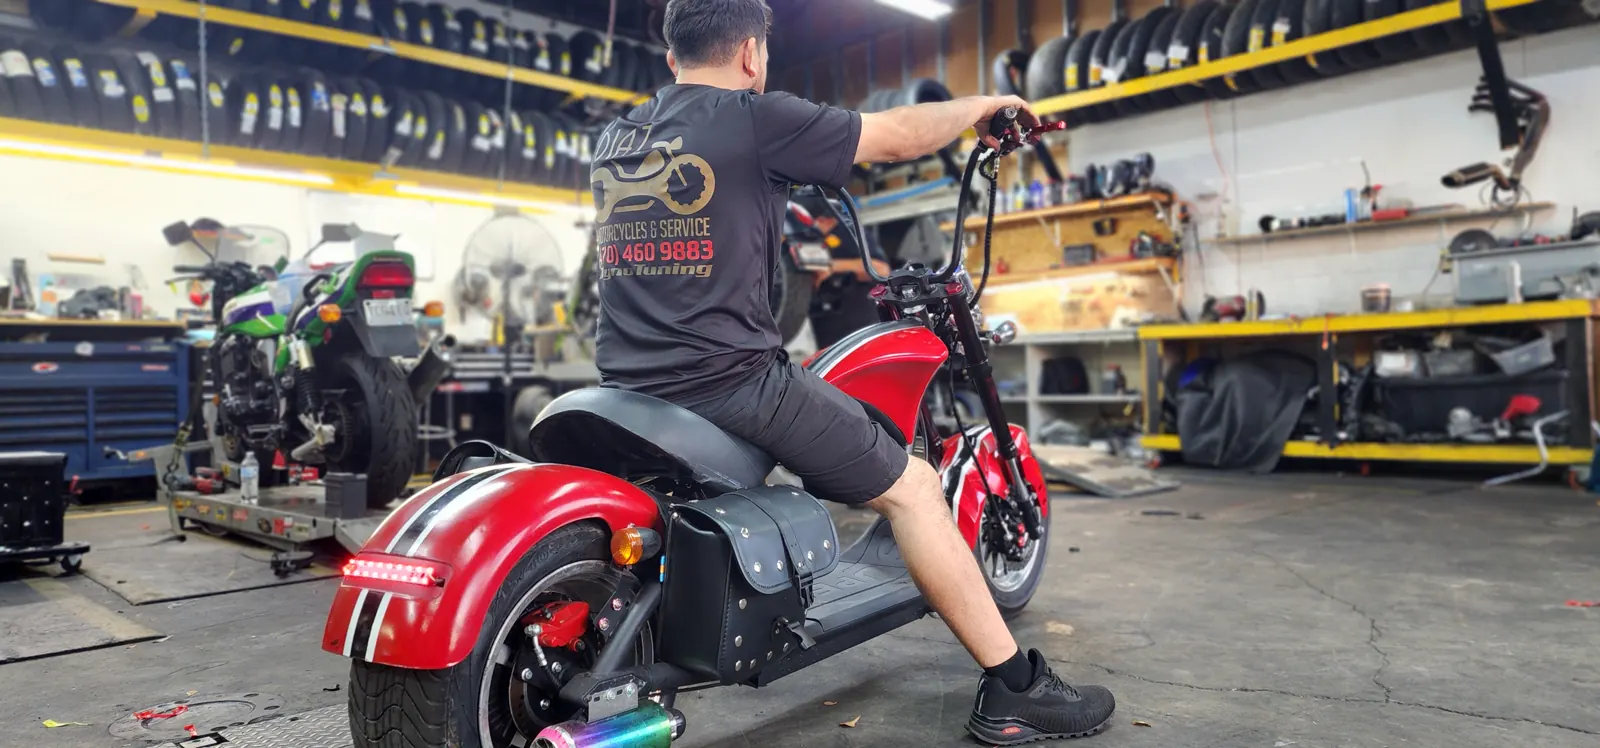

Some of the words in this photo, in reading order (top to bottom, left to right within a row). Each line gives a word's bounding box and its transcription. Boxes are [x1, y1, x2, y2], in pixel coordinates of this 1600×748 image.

[650, 220, 657, 238] &
[660, 217, 711, 238] SERVICE
[622, 241, 655, 262] 460
[660, 239, 714, 261] 9883
